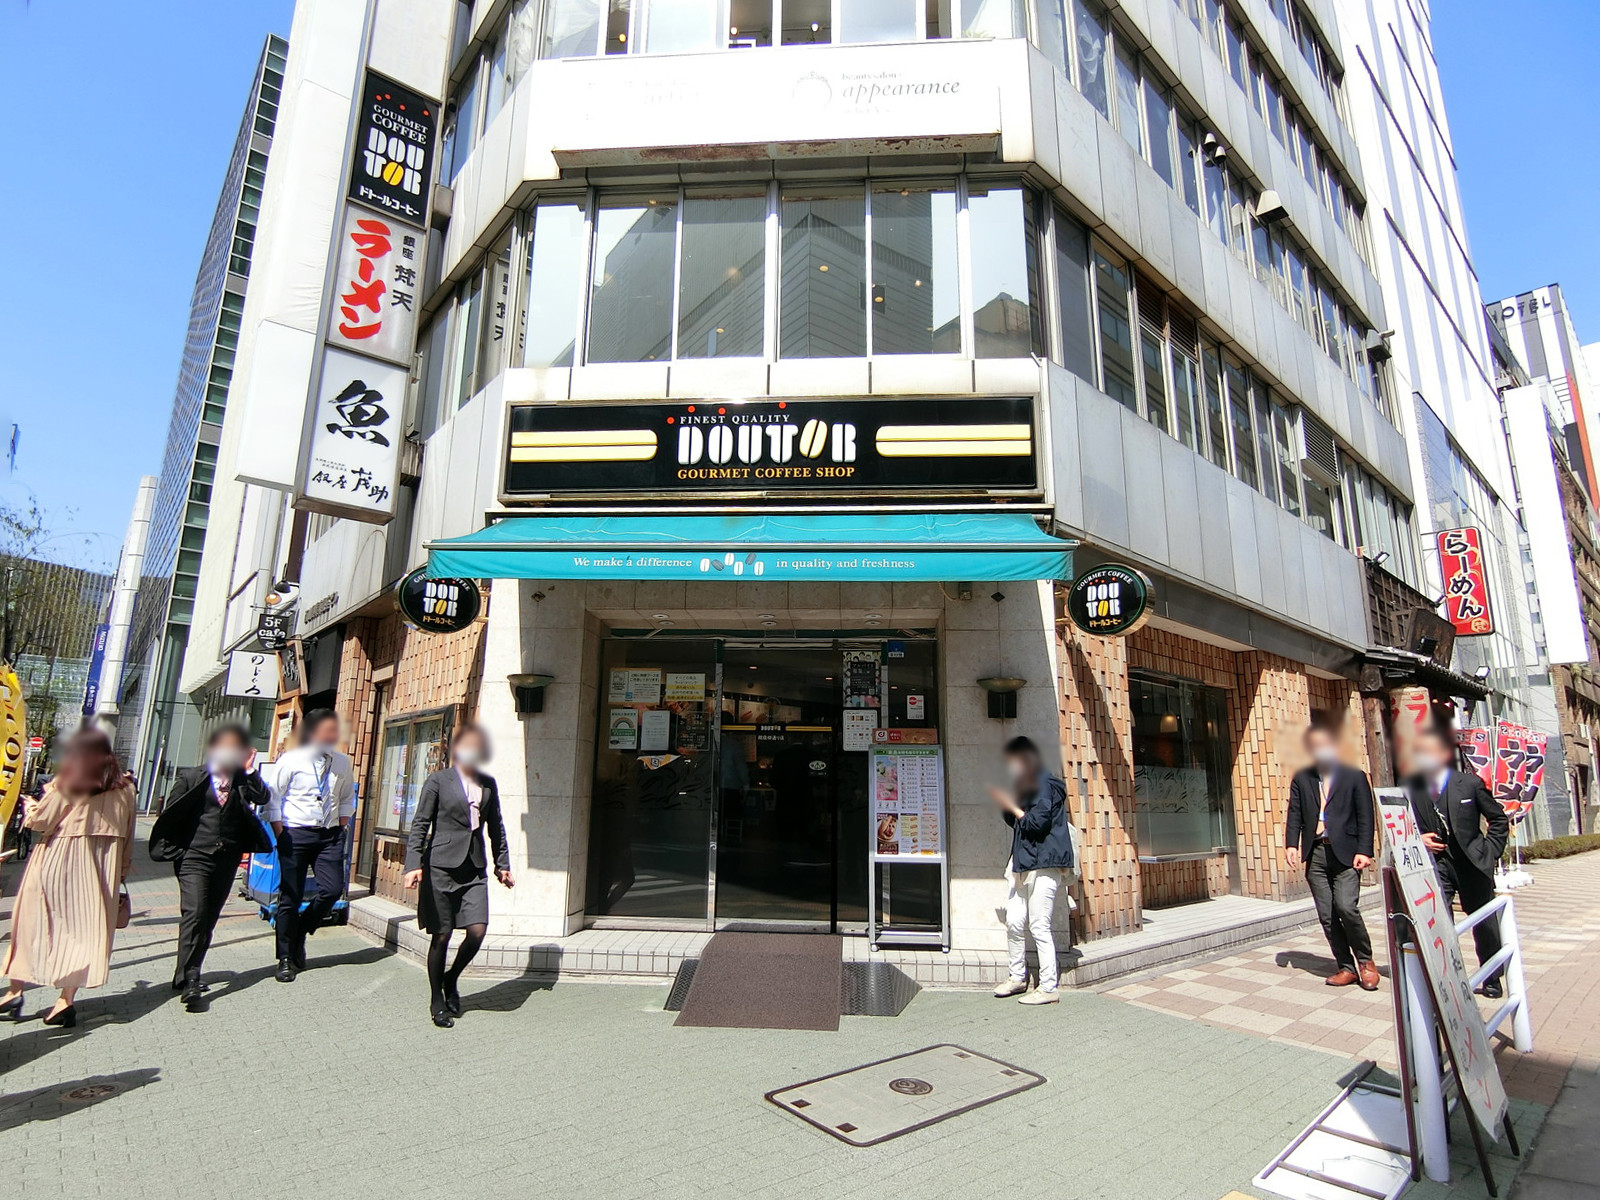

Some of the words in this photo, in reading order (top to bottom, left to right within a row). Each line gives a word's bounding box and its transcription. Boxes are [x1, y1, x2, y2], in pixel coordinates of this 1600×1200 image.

[842, 81, 960, 104] appearance
[372, 113, 427, 145] COFFEE
[373, 104, 429, 133] GOURMET
[359, 185, 420, 216] ドトールコーヒー
[338, 219, 392, 340] ラーメン
[326, 379, 390, 448] 魚
[680, 415, 725, 424] FINEST
[731, 414, 791, 424] QUALITY
[678, 418, 857, 465] DOUTOR
[677, 467, 750, 479] GOURMET
[755, 467, 812, 479] COFFEE
[815, 466, 855, 478] SHOP
[573, 557, 590, 566] We
[593, 557, 623, 567] make
[626, 558, 633, 567] a
[636, 557, 692, 567] difference
[776, 559, 788, 568] in
[792, 558, 833, 571] quality
[836, 558, 857, 568] and
[861, 557, 915, 568] freshness
[1076, 571, 1107, 591] GOURMET
[1107, 570, 1133, 585] COFFEE
[1446, 534, 1483, 618] らーめん
[264, 616, 283, 628] 5F
[422, 615, 456, 625] ドトールコーヒー
[1089, 618, 1122, 628] ドトールコーヒー
[259, 628, 286, 639] cafe
